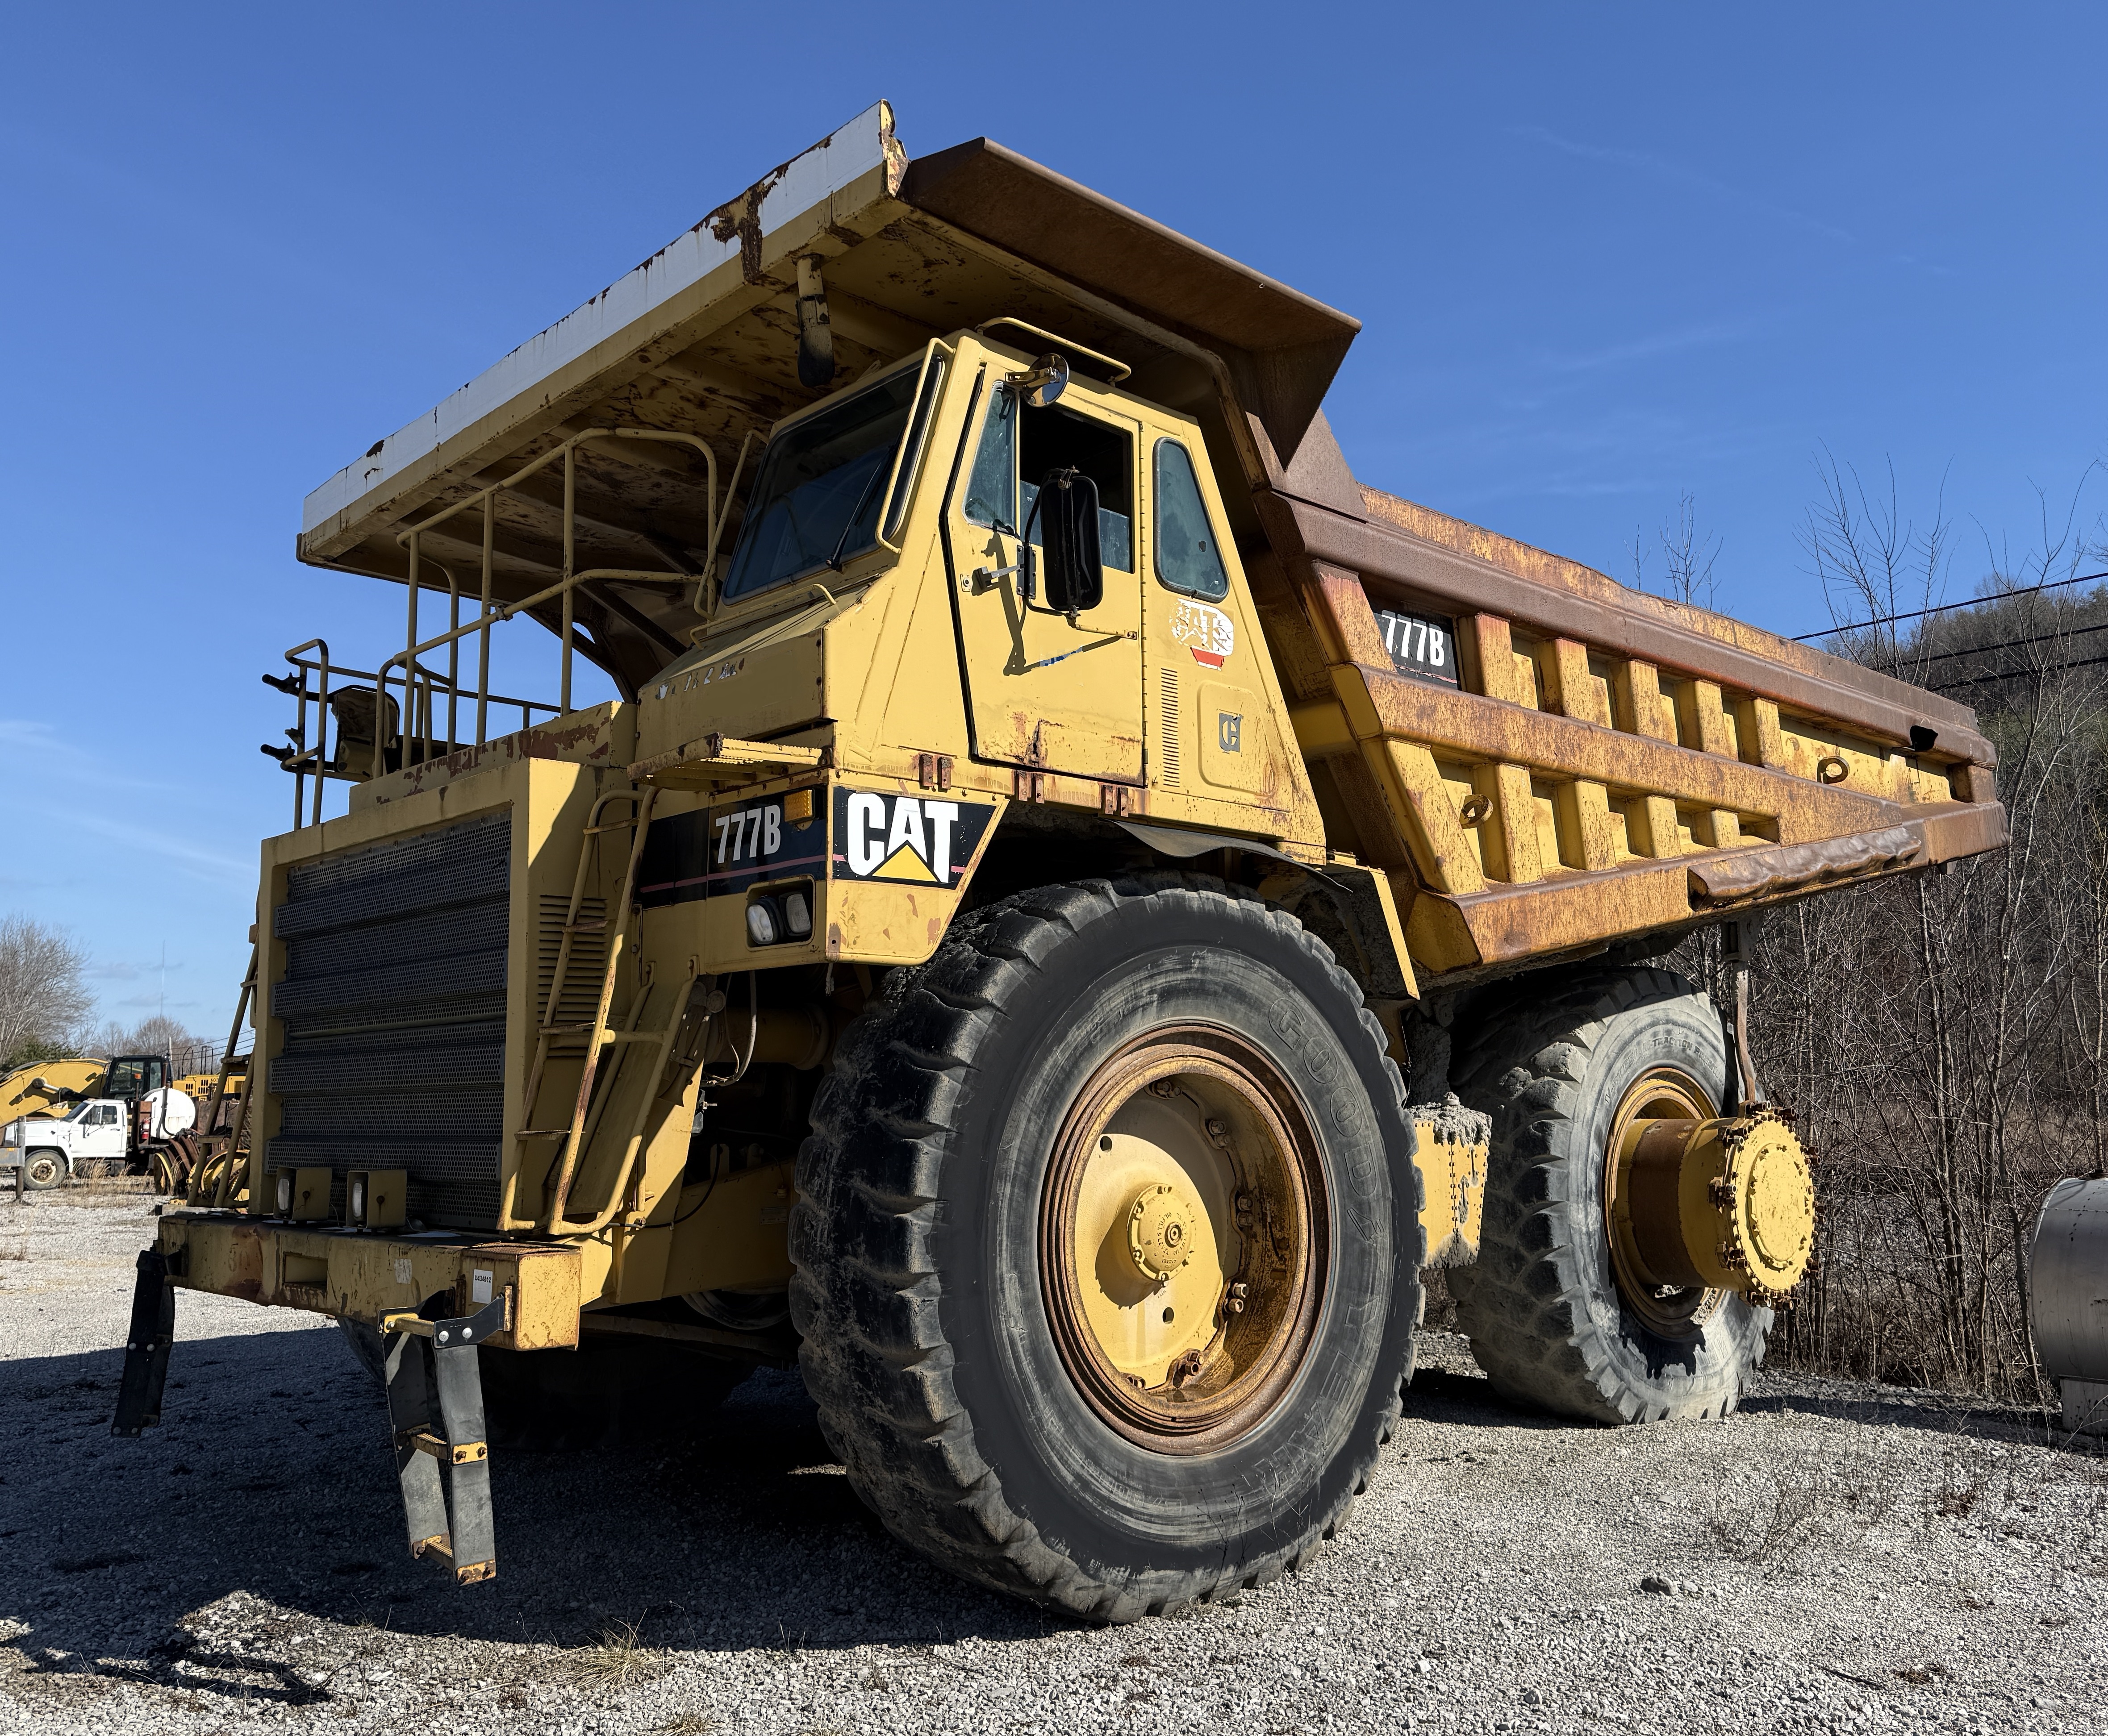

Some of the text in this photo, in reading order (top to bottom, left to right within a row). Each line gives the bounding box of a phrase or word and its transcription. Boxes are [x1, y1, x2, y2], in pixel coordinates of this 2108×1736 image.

[1381, 610, 1444, 667] 777B
[716, 804, 781, 864] 777B
[847, 792, 959, 883] CAT
